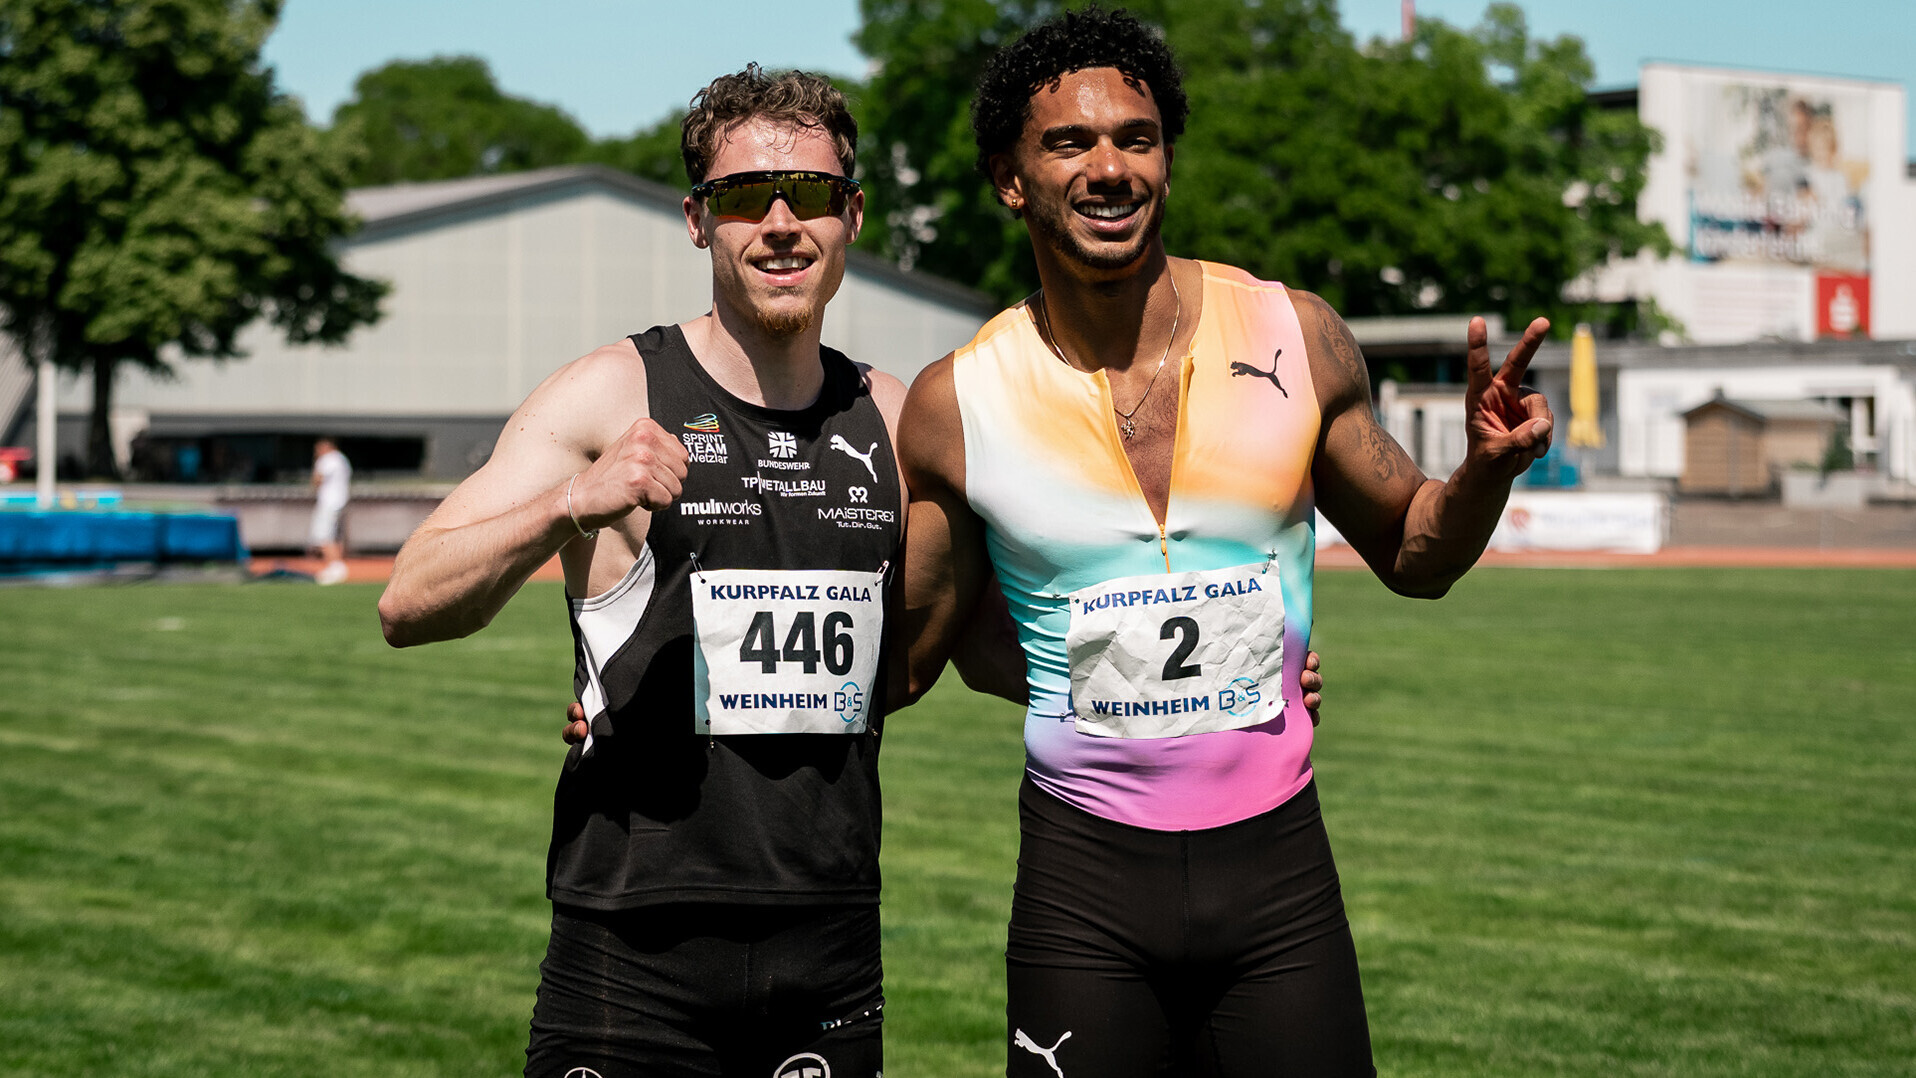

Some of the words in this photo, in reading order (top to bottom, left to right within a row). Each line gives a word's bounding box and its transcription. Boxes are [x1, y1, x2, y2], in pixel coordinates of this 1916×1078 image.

[682, 433, 724, 443] SPRINT
[684, 442, 727, 455] TEAM
[688, 452, 728, 464] Wetzlar
[757, 459, 810, 470] BUNDESWEHR
[710, 585, 820, 600] KURPFALZ
[826, 586, 872, 602] GALA
[1083, 585, 1197, 615] KURPFALZ
[1205, 577, 1262, 599] GALA
[739, 611, 854, 676] 446
[1160, 616, 1202, 681] 2
[719, 693, 828, 709] WEINHEIM
[1091, 695, 1210, 717] WEINHEIM
